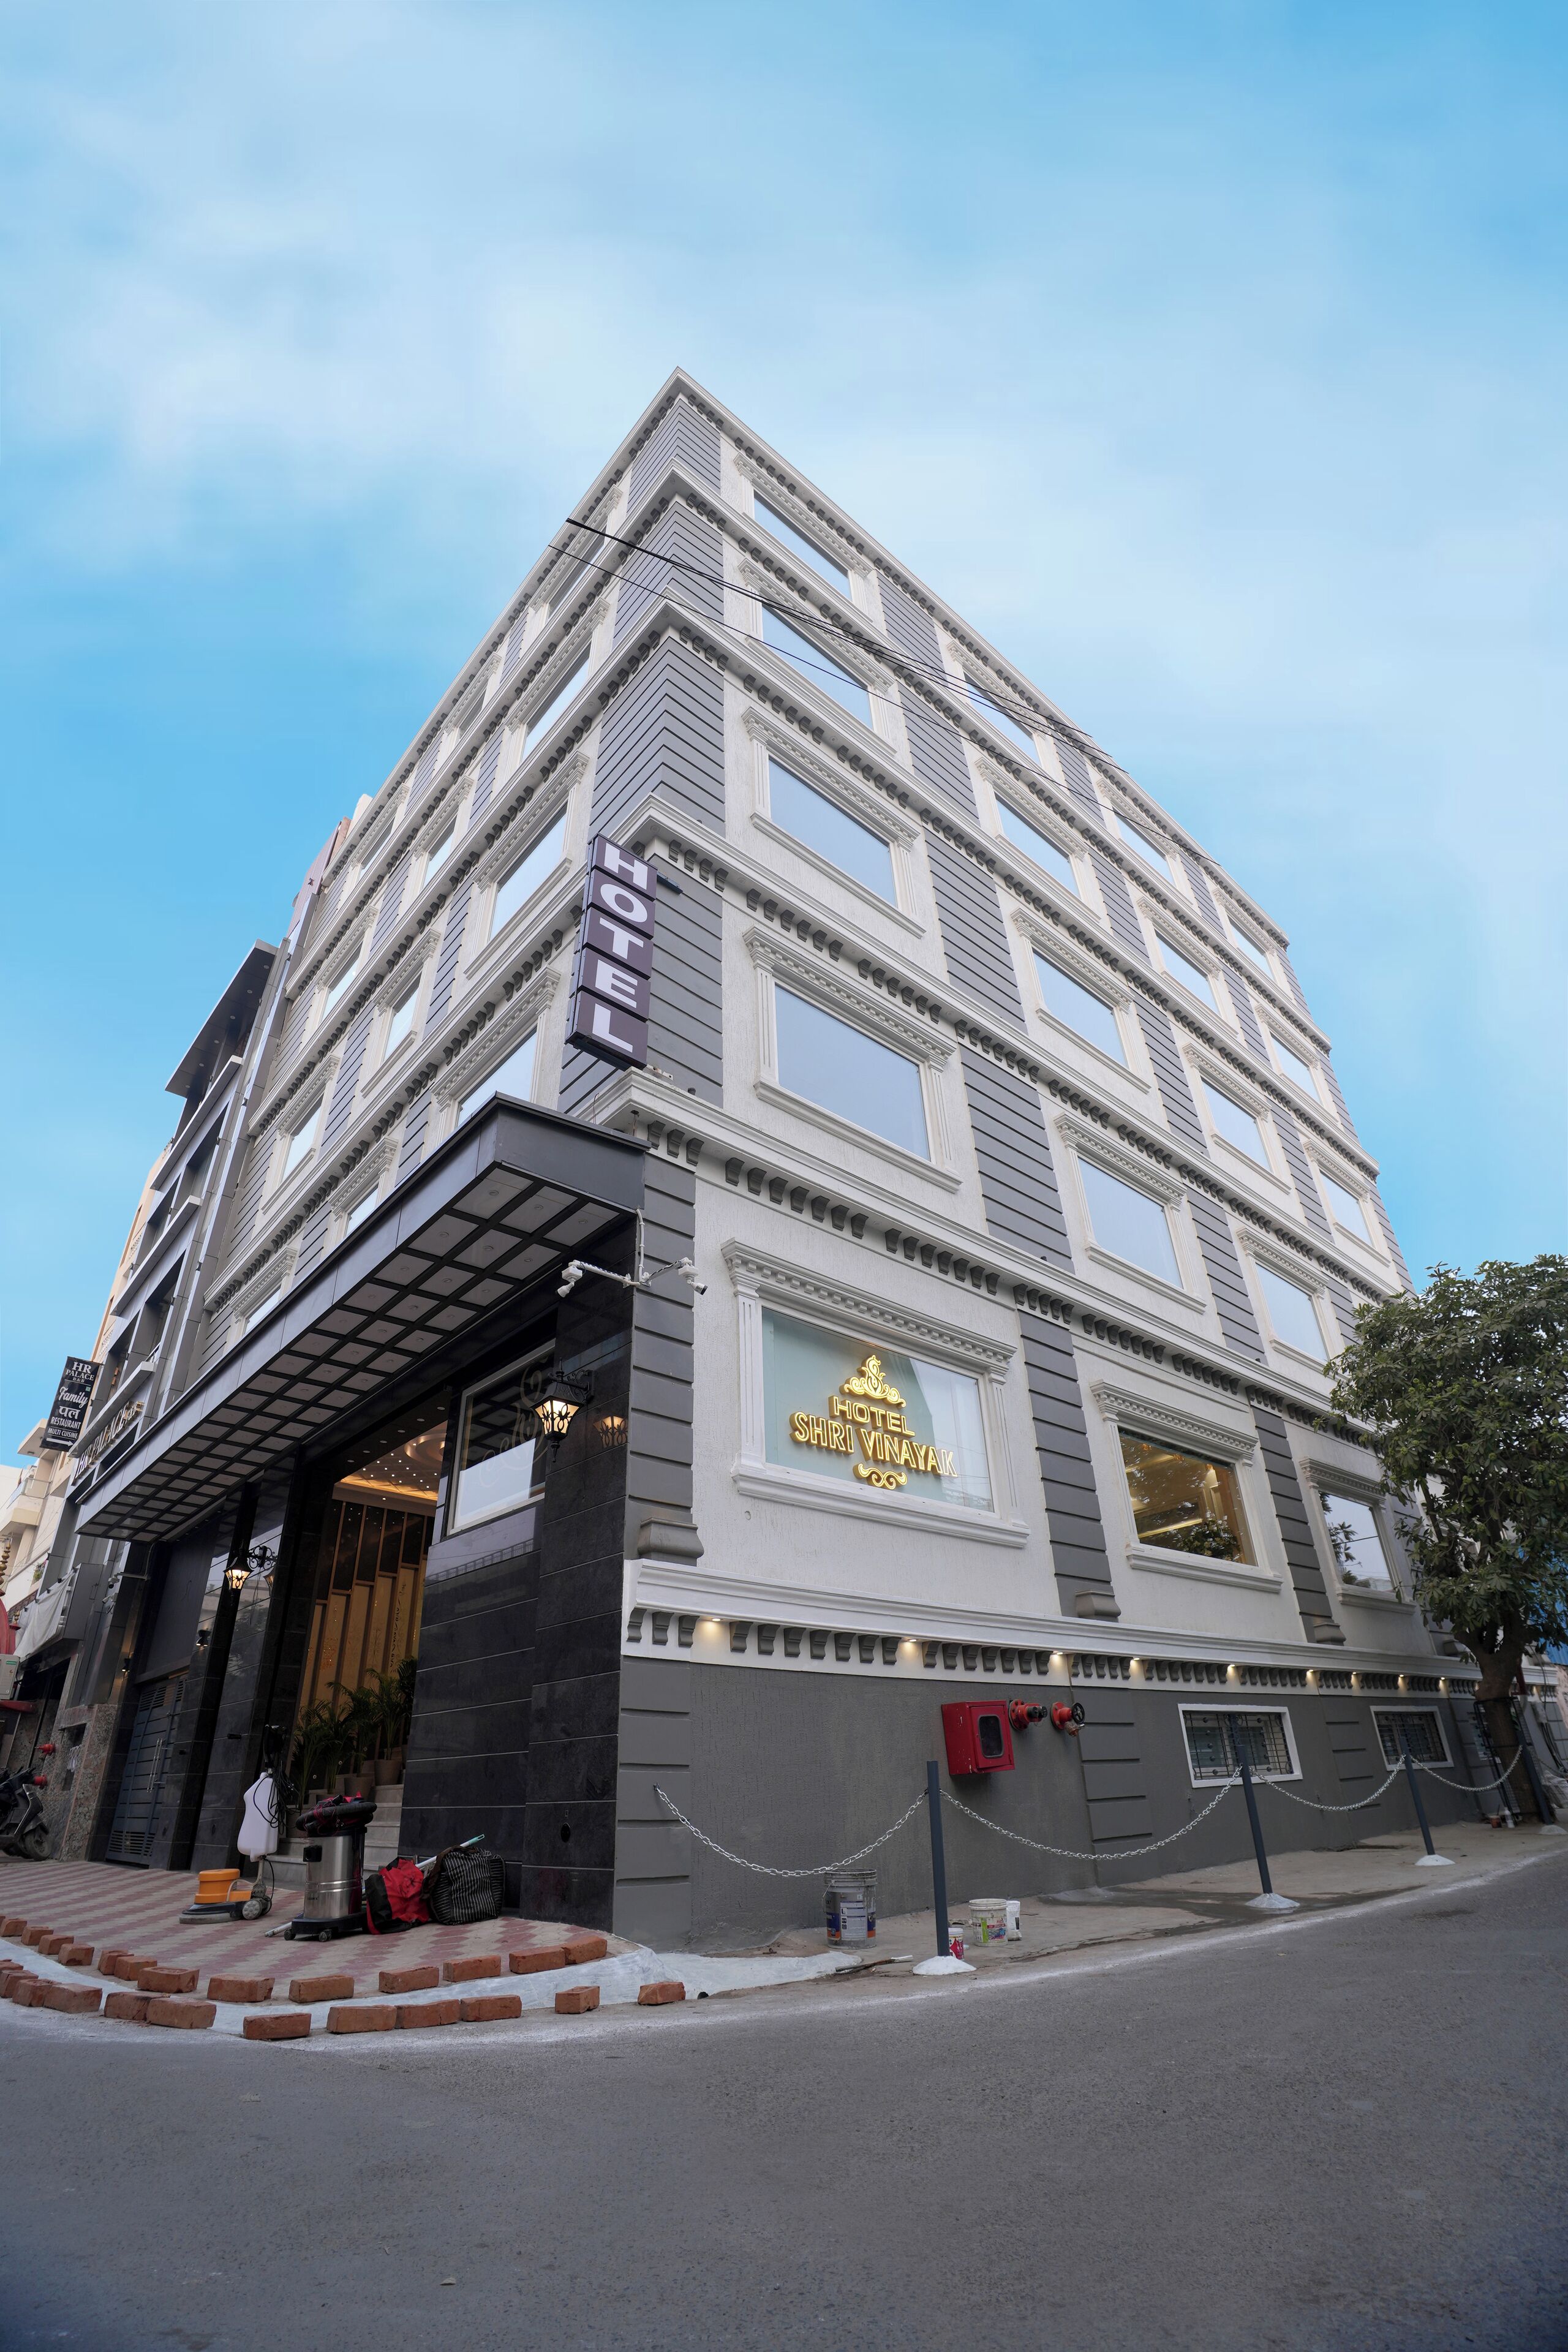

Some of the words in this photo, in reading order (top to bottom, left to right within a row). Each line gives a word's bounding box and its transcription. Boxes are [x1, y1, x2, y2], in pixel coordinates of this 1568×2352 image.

[592, 842, 649, 1053] HOTEL
[66, 1369, 95, 1381] PALACE
[72, 1362, 92, 1374] HR
[58, 1387, 88, 1408] Family
[59, 1406, 81, 1419] पल
[829, 1395, 916, 1438] HOTEL
[50, 1416, 81, 1430] RESTAURANT
[790, 1411, 854, 1455] SHRI
[856, 1427, 959, 1477] VINAYAK
